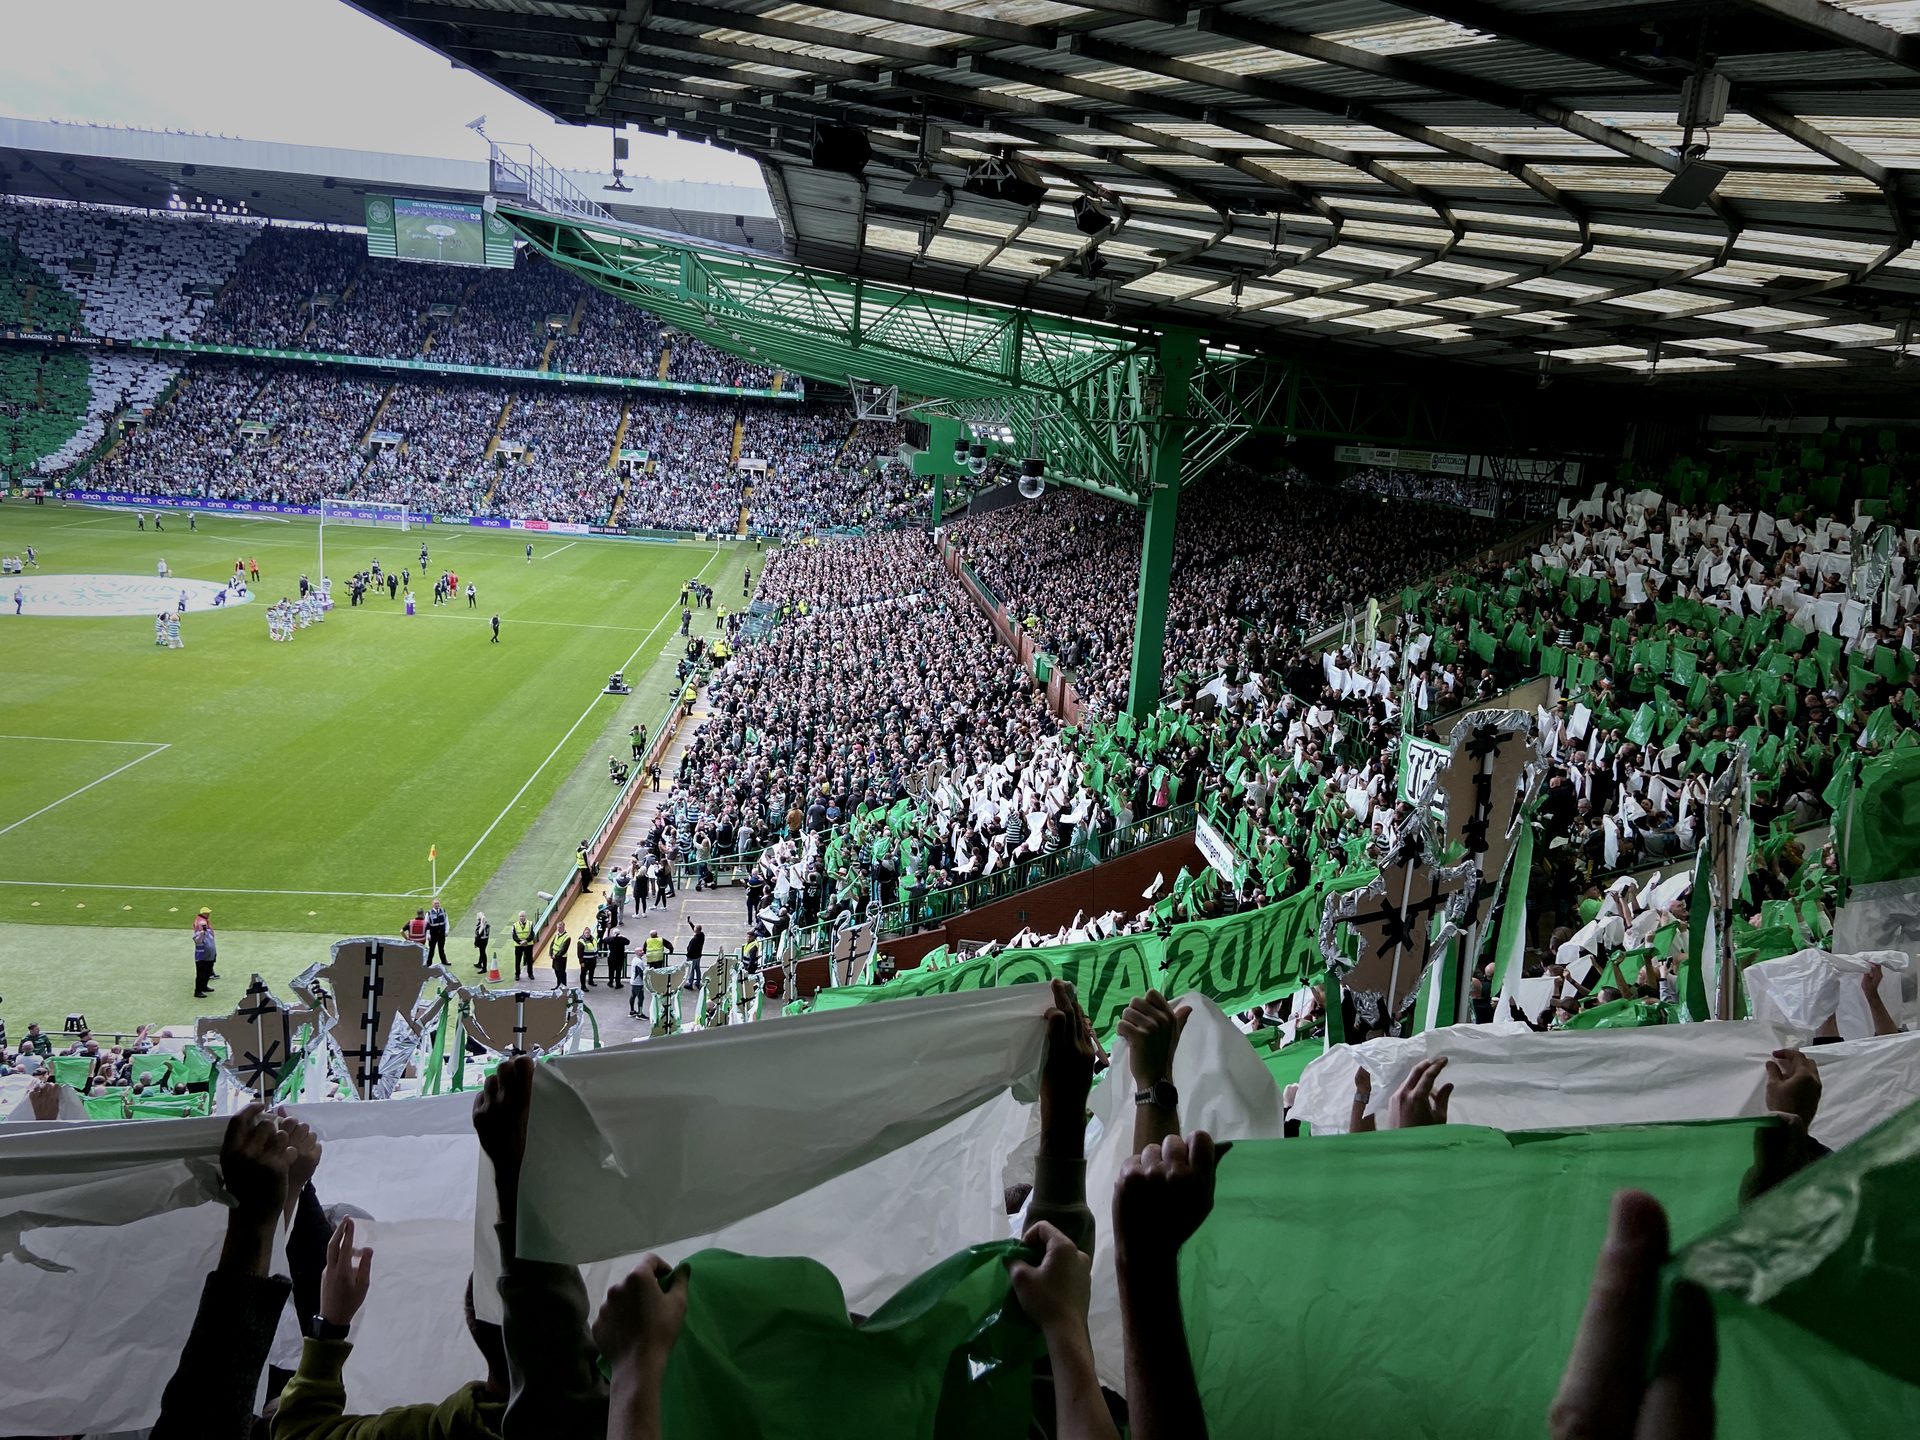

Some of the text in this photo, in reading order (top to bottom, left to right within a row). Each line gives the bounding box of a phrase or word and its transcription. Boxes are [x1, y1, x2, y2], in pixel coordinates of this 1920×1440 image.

[20, 332, 52, 341] MAGNERS
[70, 336, 101, 344] MAGNERS
[56, 491, 75, 499] cch
[82, 493, 101, 501] cinch
[107, 495, 126, 503] cinch
[132, 496, 151, 504] cinch
[157, 498, 178, 506] cinc
[182, 499, 201, 507] cinch
[207, 501, 226, 509] cinch
[233, 503, 252, 511] cinch
[333, 509, 352, 517] cinch
[441, 515, 470, 525] dafabet
[512, 521, 547, 529] sky sports
[807, 888, 817, 898] 42
